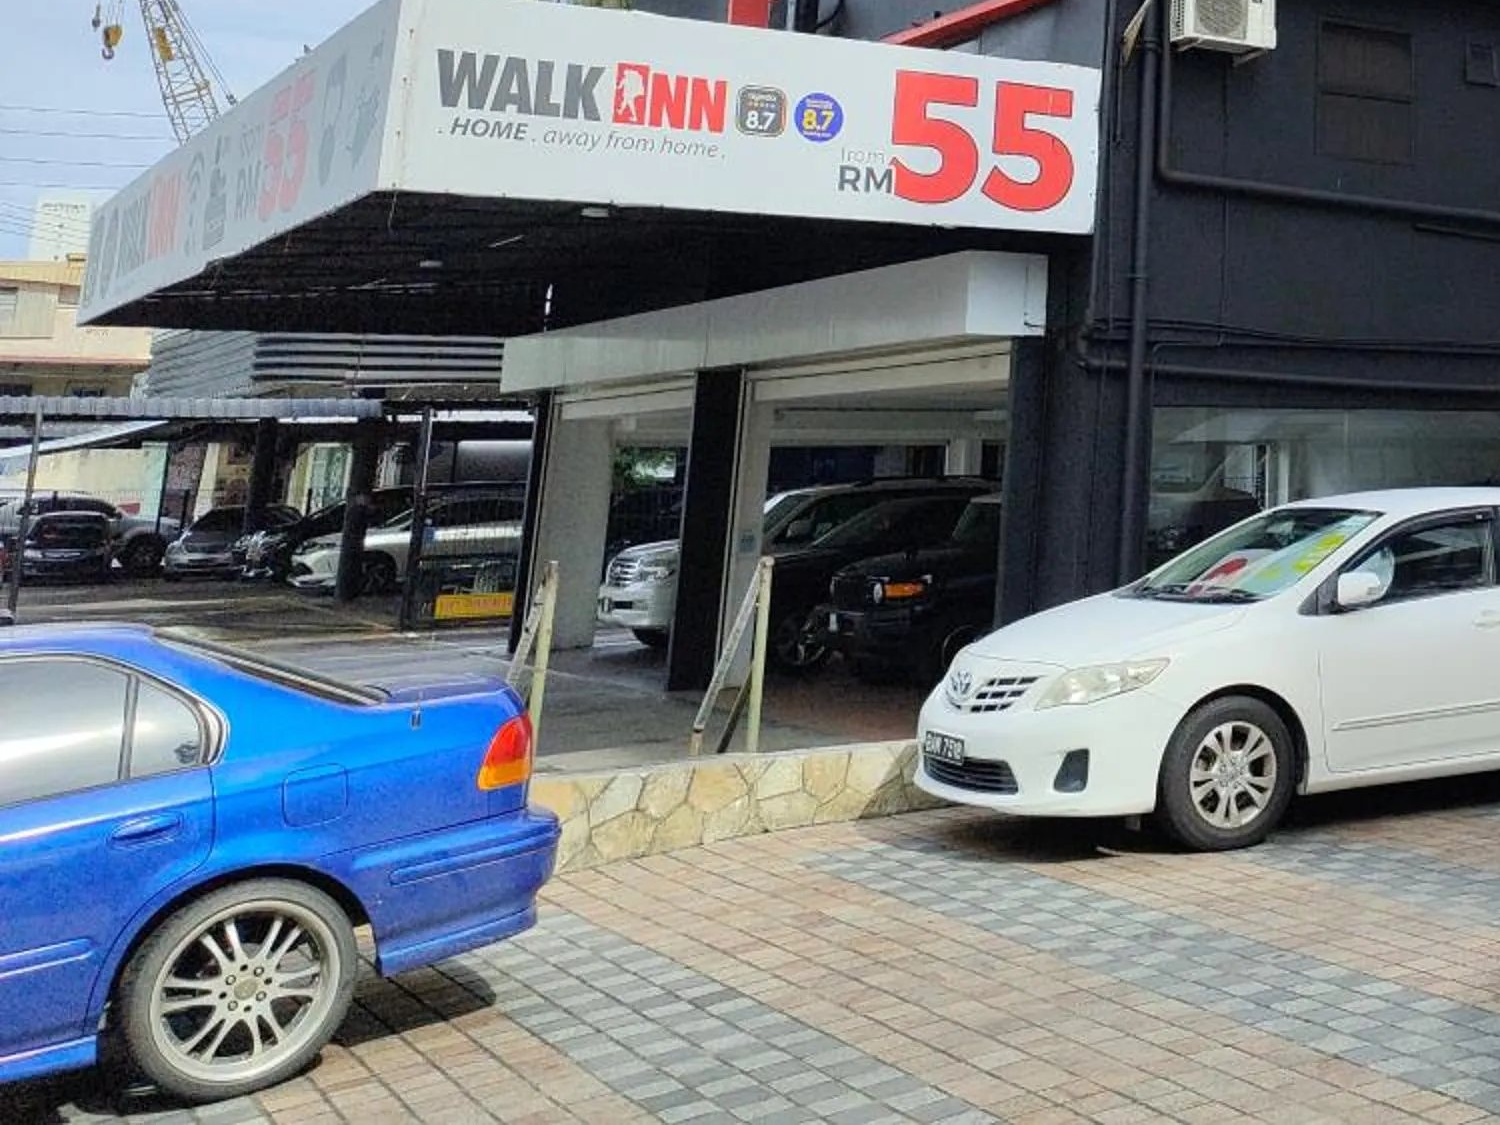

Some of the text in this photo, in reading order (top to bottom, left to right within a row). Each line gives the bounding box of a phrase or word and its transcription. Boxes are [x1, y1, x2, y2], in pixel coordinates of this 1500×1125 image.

[437, 49, 606, 122] WALK
[543, 128, 600, 153] away
[605, 130, 655, 153] from
[746, 110, 776, 131] 8.7
[802, 108, 835, 131] 8.7
[837, 69, 1075, 213] RM 55
[257, 70, 316, 222] 55
